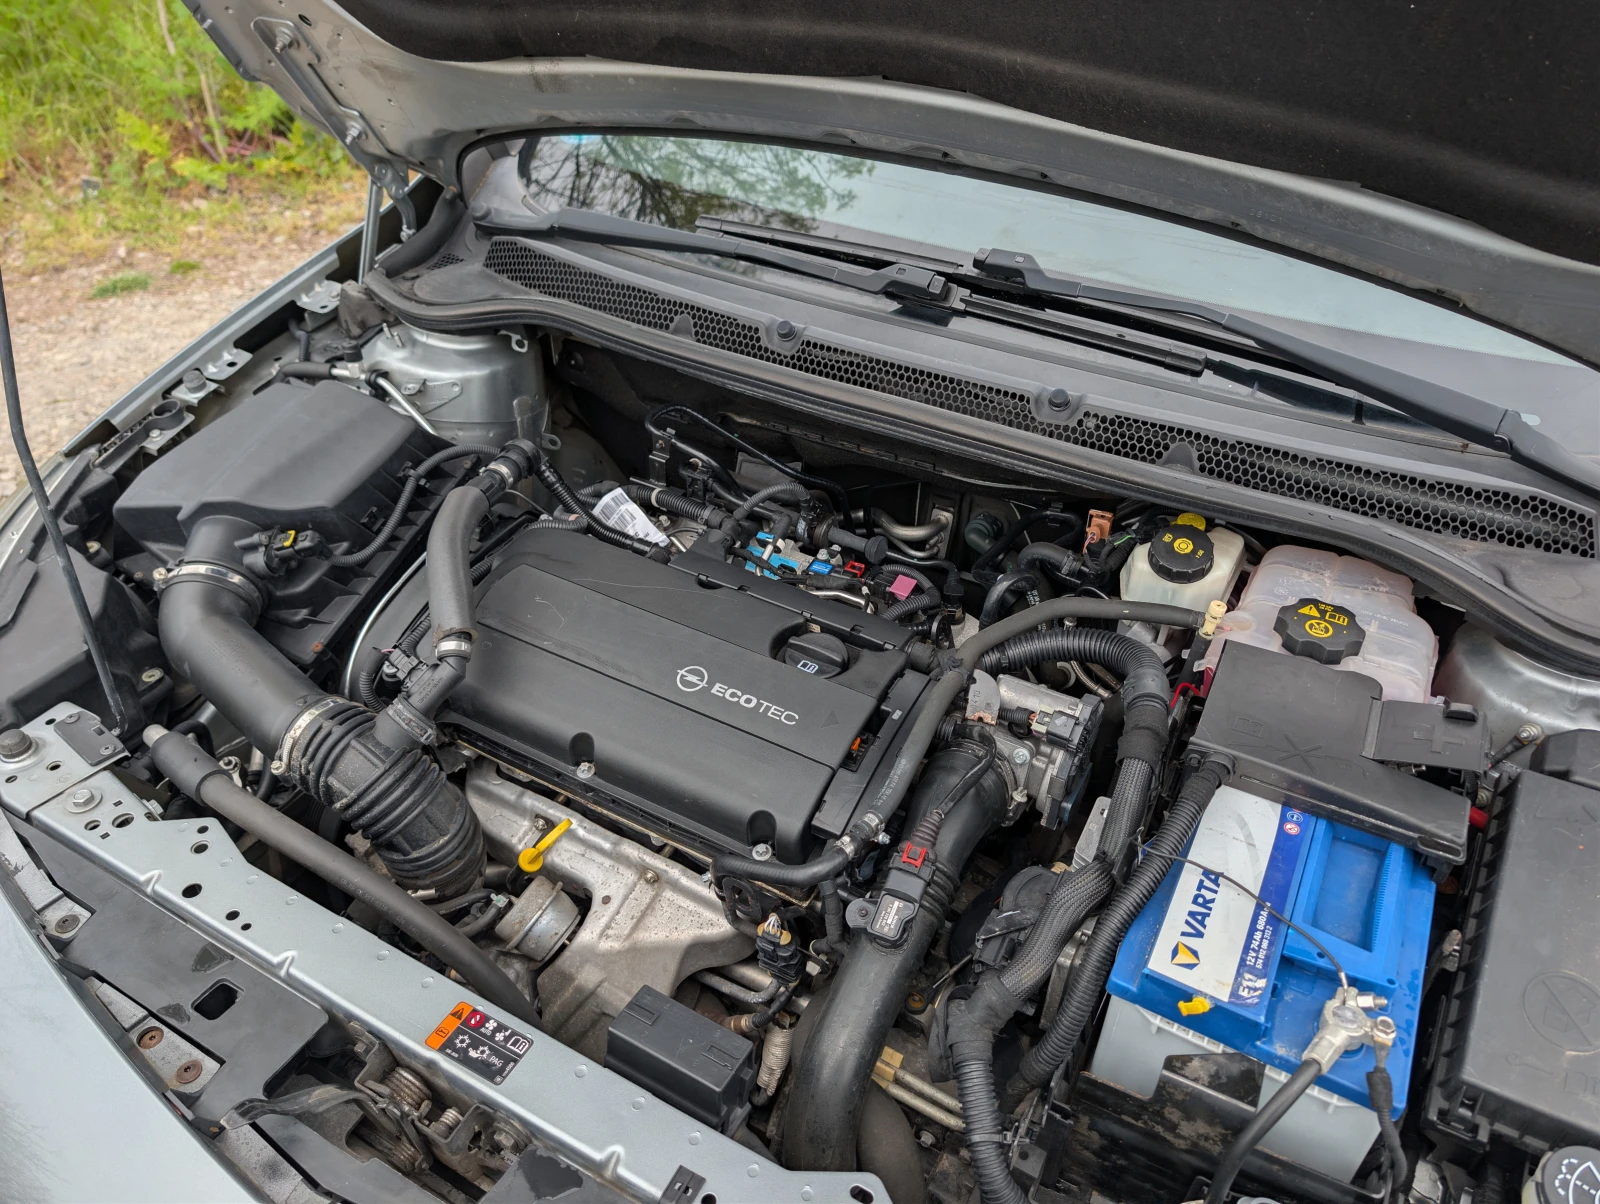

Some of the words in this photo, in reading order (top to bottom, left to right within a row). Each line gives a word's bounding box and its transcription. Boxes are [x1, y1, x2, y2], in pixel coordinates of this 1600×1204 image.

[711, 683, 799, 725] ECOTEC
[1180, 869, 1225, 939] VARTA
[1246, 950, 1256, 966] 12V
[1251, 930, 1262, 950] 74Ah
[480, 1028, 492, 1036] AUTO
[489, 1056, 504, 1067] PAG
